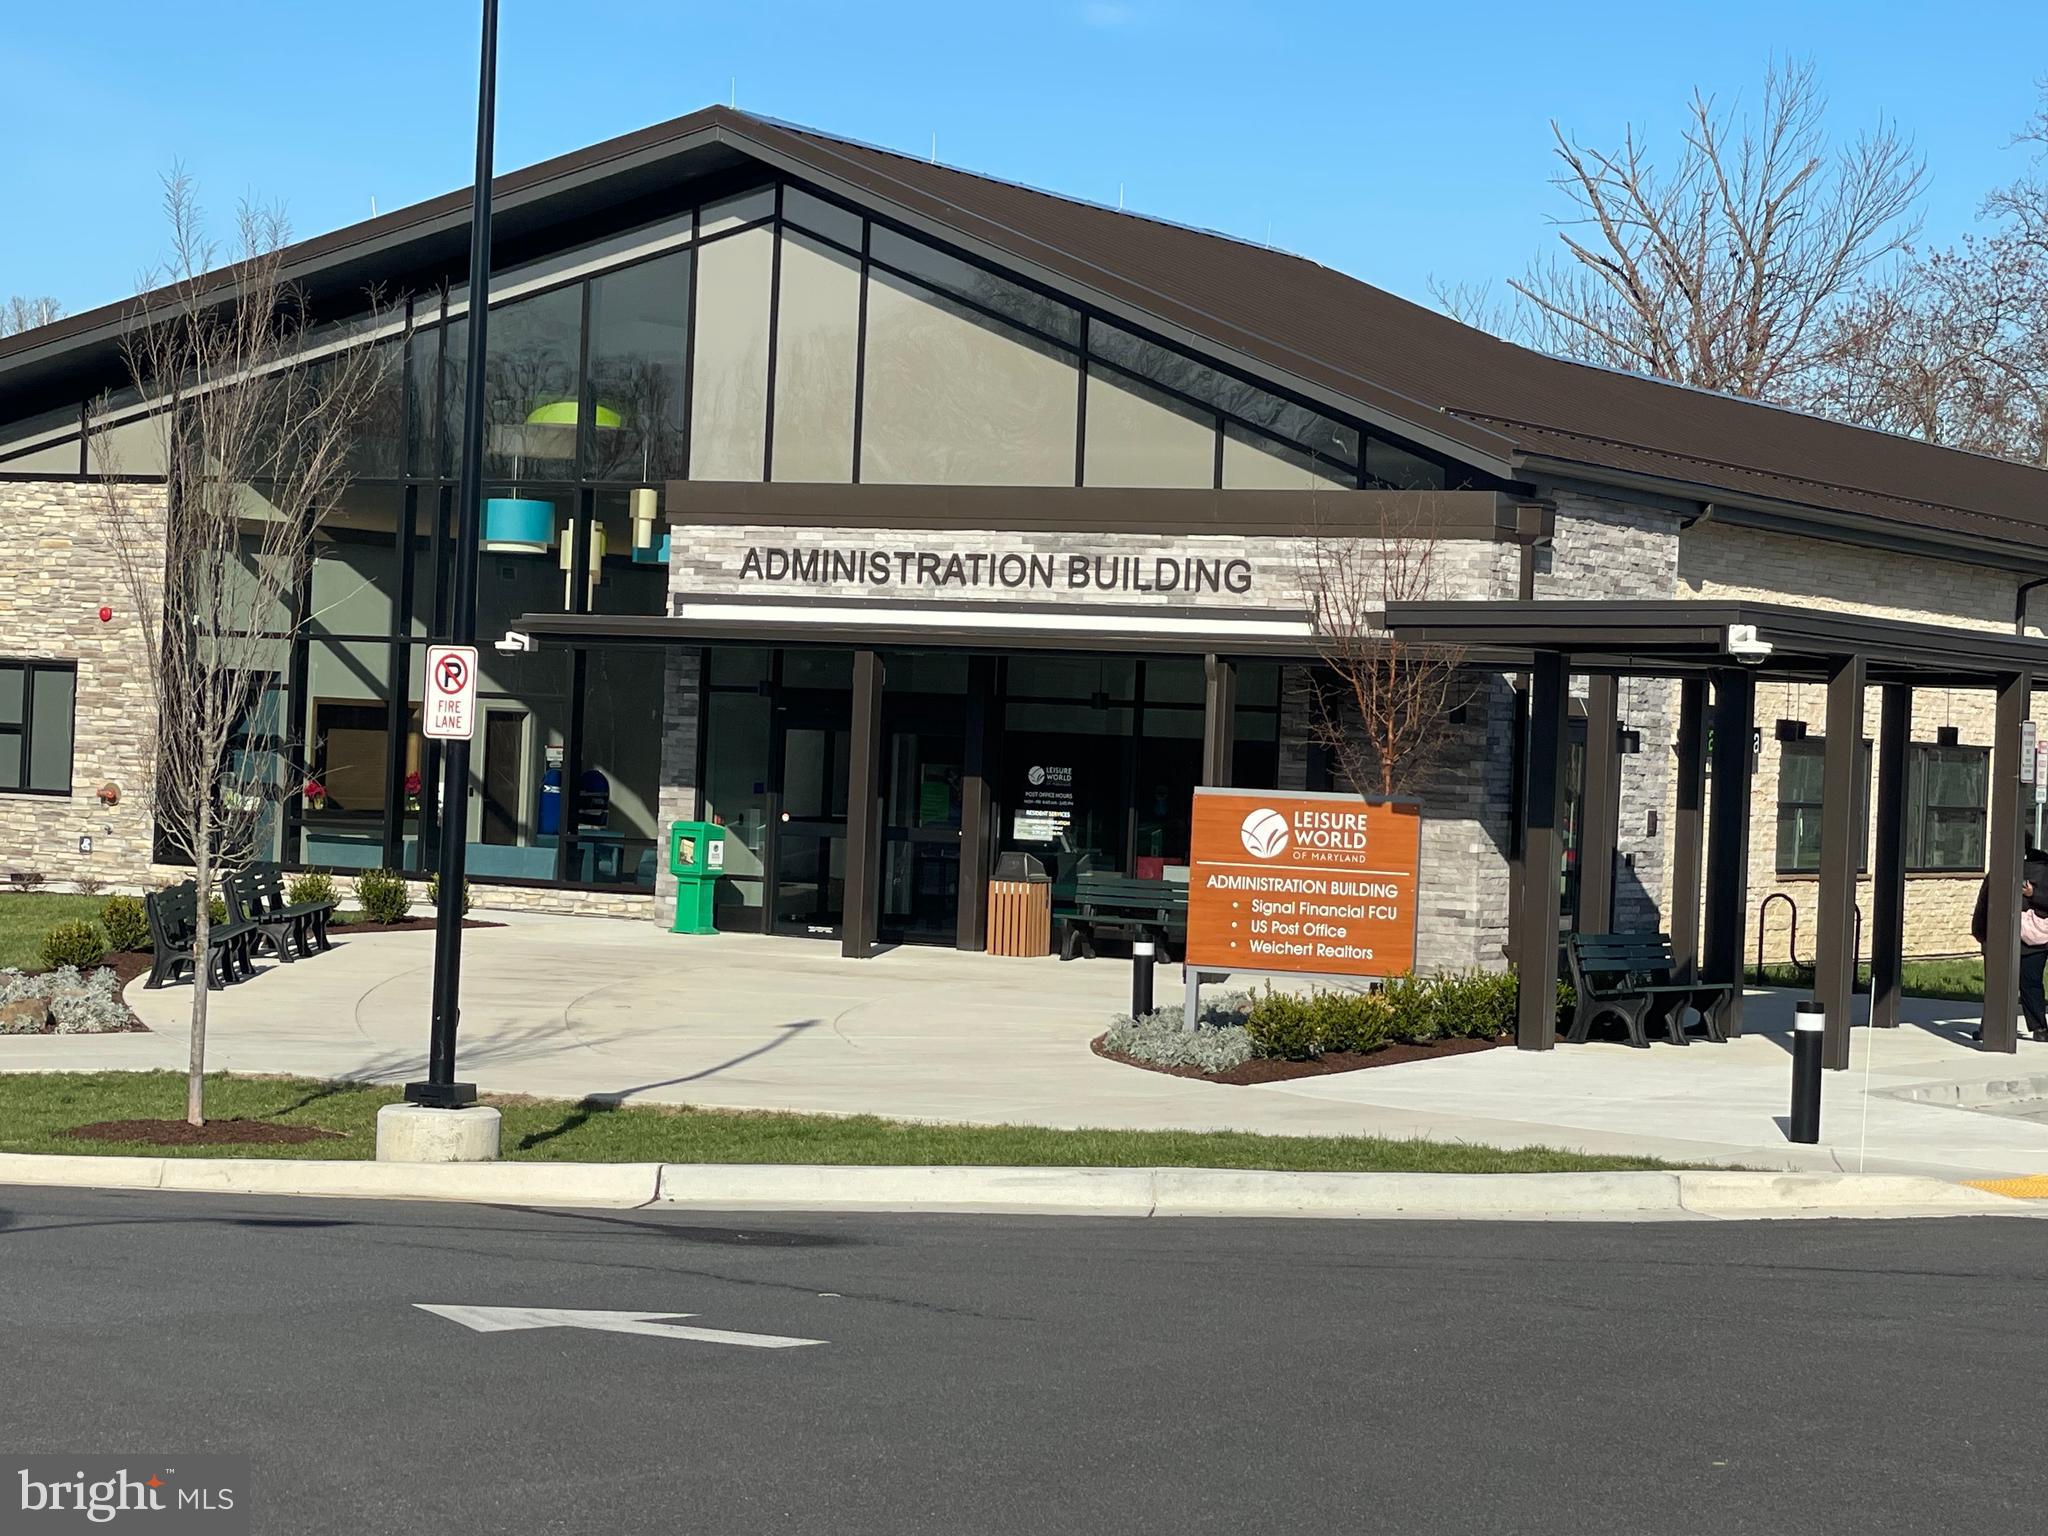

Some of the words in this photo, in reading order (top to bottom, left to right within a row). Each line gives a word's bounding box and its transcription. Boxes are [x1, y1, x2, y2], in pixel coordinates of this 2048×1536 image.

[739, 547, 1054, 588] ADMINISTRATION
[1068, 555, 1252, 594] BUILDING
[438, 700, 461, 713] FIRE
[435, 715, 462, 728] LANE
[1294, 811, 1367, 831] LEISURE
[1294, 830, 1367, 849] WORLD
[1293, 851, 1307, 860] OF
[1311, 852, 1366, 863] MARYLAND
[1207, 875, 1326, 895] ADMINISTRATION
[1331, 882, 1398, 899] BUILDING
[1252, 899, 1295, 917] Signal
[1299, 902, 1364, 918] Financial
[1368, 906, 1397, 920] FCU
[1251, 920, 1267, 933] US
[1272, 921, 1299, 935] Post
[1303, 922, 1347, 938] Office
[1250, 940, 1313, 956] Weichert
[1317, 942, 1373, 960] Realtors
